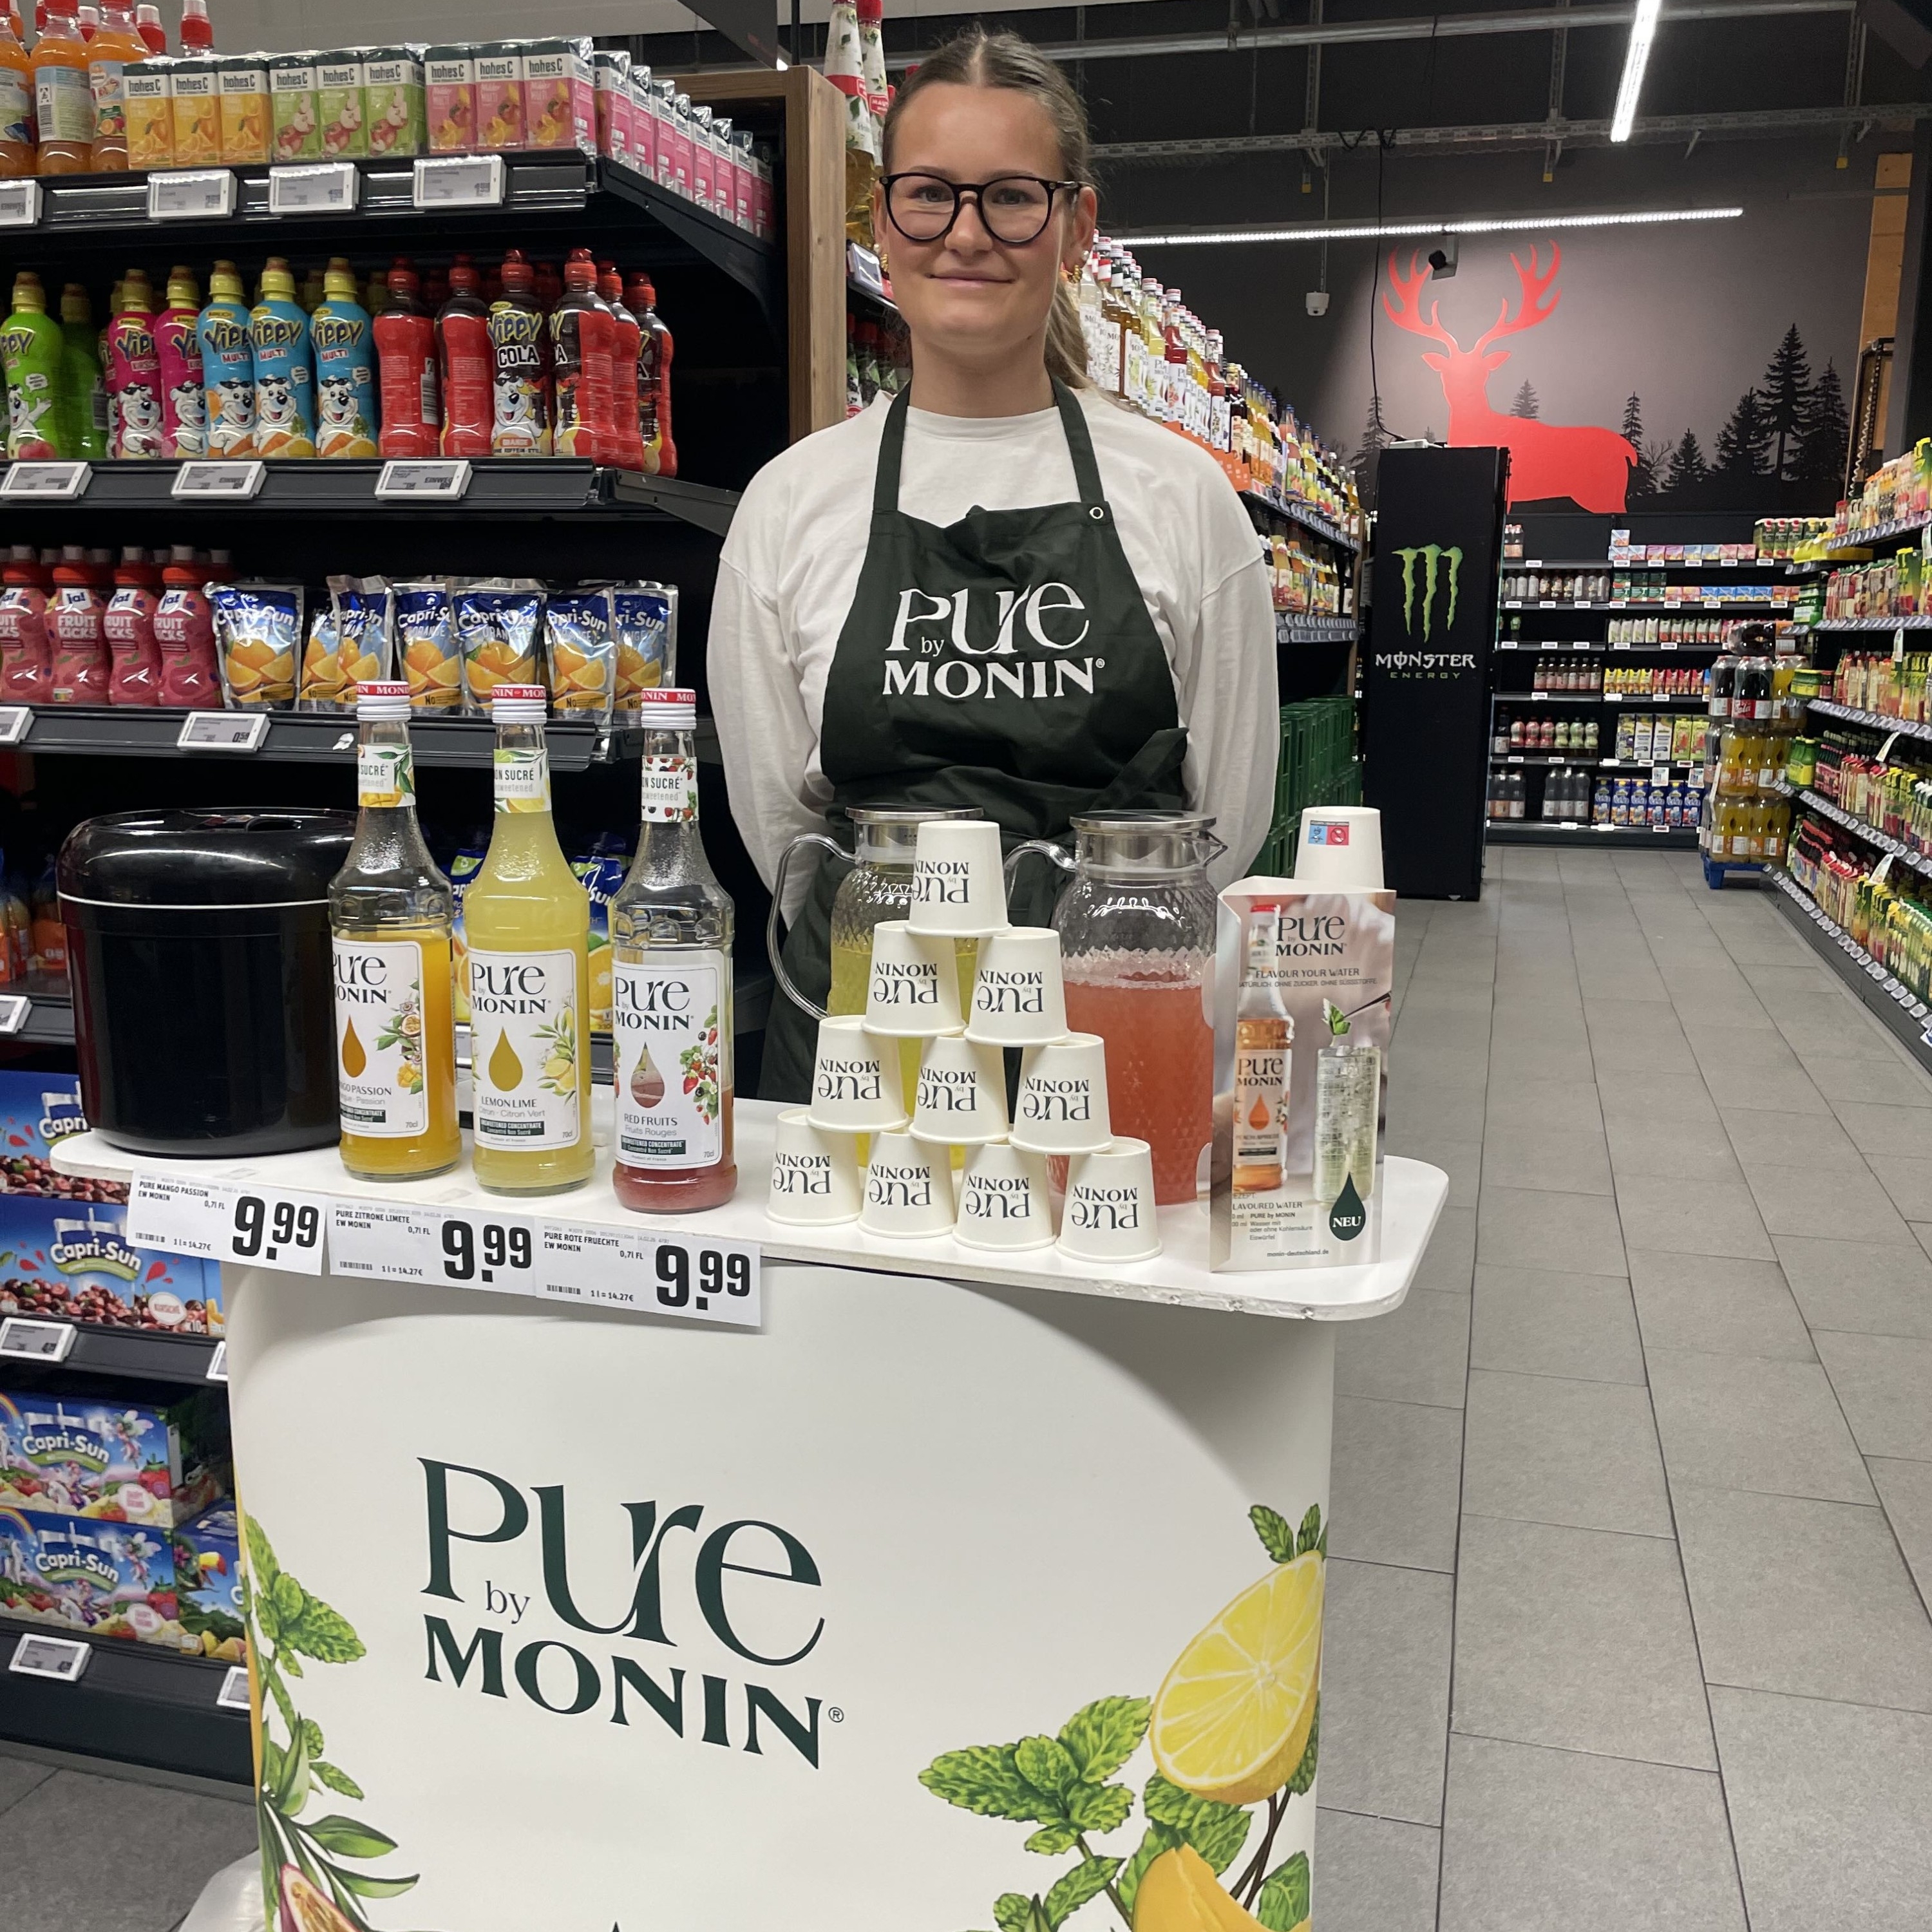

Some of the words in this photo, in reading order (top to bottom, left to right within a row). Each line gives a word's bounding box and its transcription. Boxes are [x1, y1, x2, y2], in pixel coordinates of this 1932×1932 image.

[370, 66, 395, 79] hohes
[395, 64, 401, 77] C
[431, 66, 457, 78] hohes
[459, 64, 464, 76] C
[480, 62, 506, 75] hohes
[507, 61, 513, 73] C
[529, 59, 556, 73] hohes
[557, 58, 562, 70] C
[224, 76, 249, 88] hohes
[249, 74, 255, 87] C
[277, 73, 302, 85] hohes
[303, 72, 307, 84] C
[323, 70, 348, 82] hohes
[349, 68, 354, 80] C
[129, 80, 155, 92] hohes
[155, 79, 160, 91] C
[176, 79, 202, 91] hohes
[202, 77, 208, 89] C
[260, 349, 285, 360] MULTI
[322, 349, 347, 360] MULTI
[498, 345, 540, 367] COLA
[66, 592, 85, 604] ja!
[113, 593, 129, 607] ja!
[162, 594, 180, 609] ja!
[0, 615, 17, 626] UIT
[58, 616, 96, 627] FRUIT
[105, 616, 132, 627] RUIT
[397, 607, 450, 628] Capri-S
[620, 611, 665, 632] ri-Sun
[886, 582, 1090, 655] Pure
[59, 627, 96, 638] KICKS
[921, 636, 944, 657] by
[1375, 651, 1476, 669] MONSTER
[522, 689, 546, 697] MON
[1277, 916, 1345, 942] Pure
[471, 962, 545, 995] Pure
[1256, 970, 1298, 978] FLAVOUR
[1302, 969, 1326, 978] YOUR
[1329, 969, 1359, 977] WATER
[615, 977, 690, 1011] Pure
[1238, 1058, 1283, 1075] Pure
[352, 1085, 392, 1095] PASSION
[482, 1096, 510, 1107] LEMON
[513, 1099, 536, 1108] LIME
[624, 1113, 639, 1124] RED
[641, 1116, 677, 1126] FRUITS
[39, 1117, 88, 1139] Capri-
[625, 1124, 643, 1134] Fruits
[645, 1128, 677, 1137] Rouges
[140, 1181, 155, 1189] PURE
[156, 1184, 179, 1193] MANGO
[181, 1188, 209, 1197] PASSION
[149, 1191, 170, 1201] MONIN
[348, 1220, 371, 1229] MONIN
[355, 1212, 384, 1221] ZITRONE
[386, 1215, 410, 1223] LIMETE
[1332, 1216, 1361, 1227] NEU
[232, 1196, 319, 1260] 9.99
[544, 1231, 562, 1240] PURE
[564, 1234, 582, 1243] ROTE
[584, 1236, 620, 1247] FRUECHTE
[50, 1238, 141, 1271] Capri-Sun
[442, 1220, 531, 1282] 9.99
[556, 1243, 581, 1252] MONIN
[656, 1245, 750, 1310] 9.99
[23, 1432, 109, 1464] Capri-Sun
[35, 1549, 118, 1583] Capri-Sun
[417, 1457, 825, 1666] Pure
[486, 1580, 531, 1624] by
